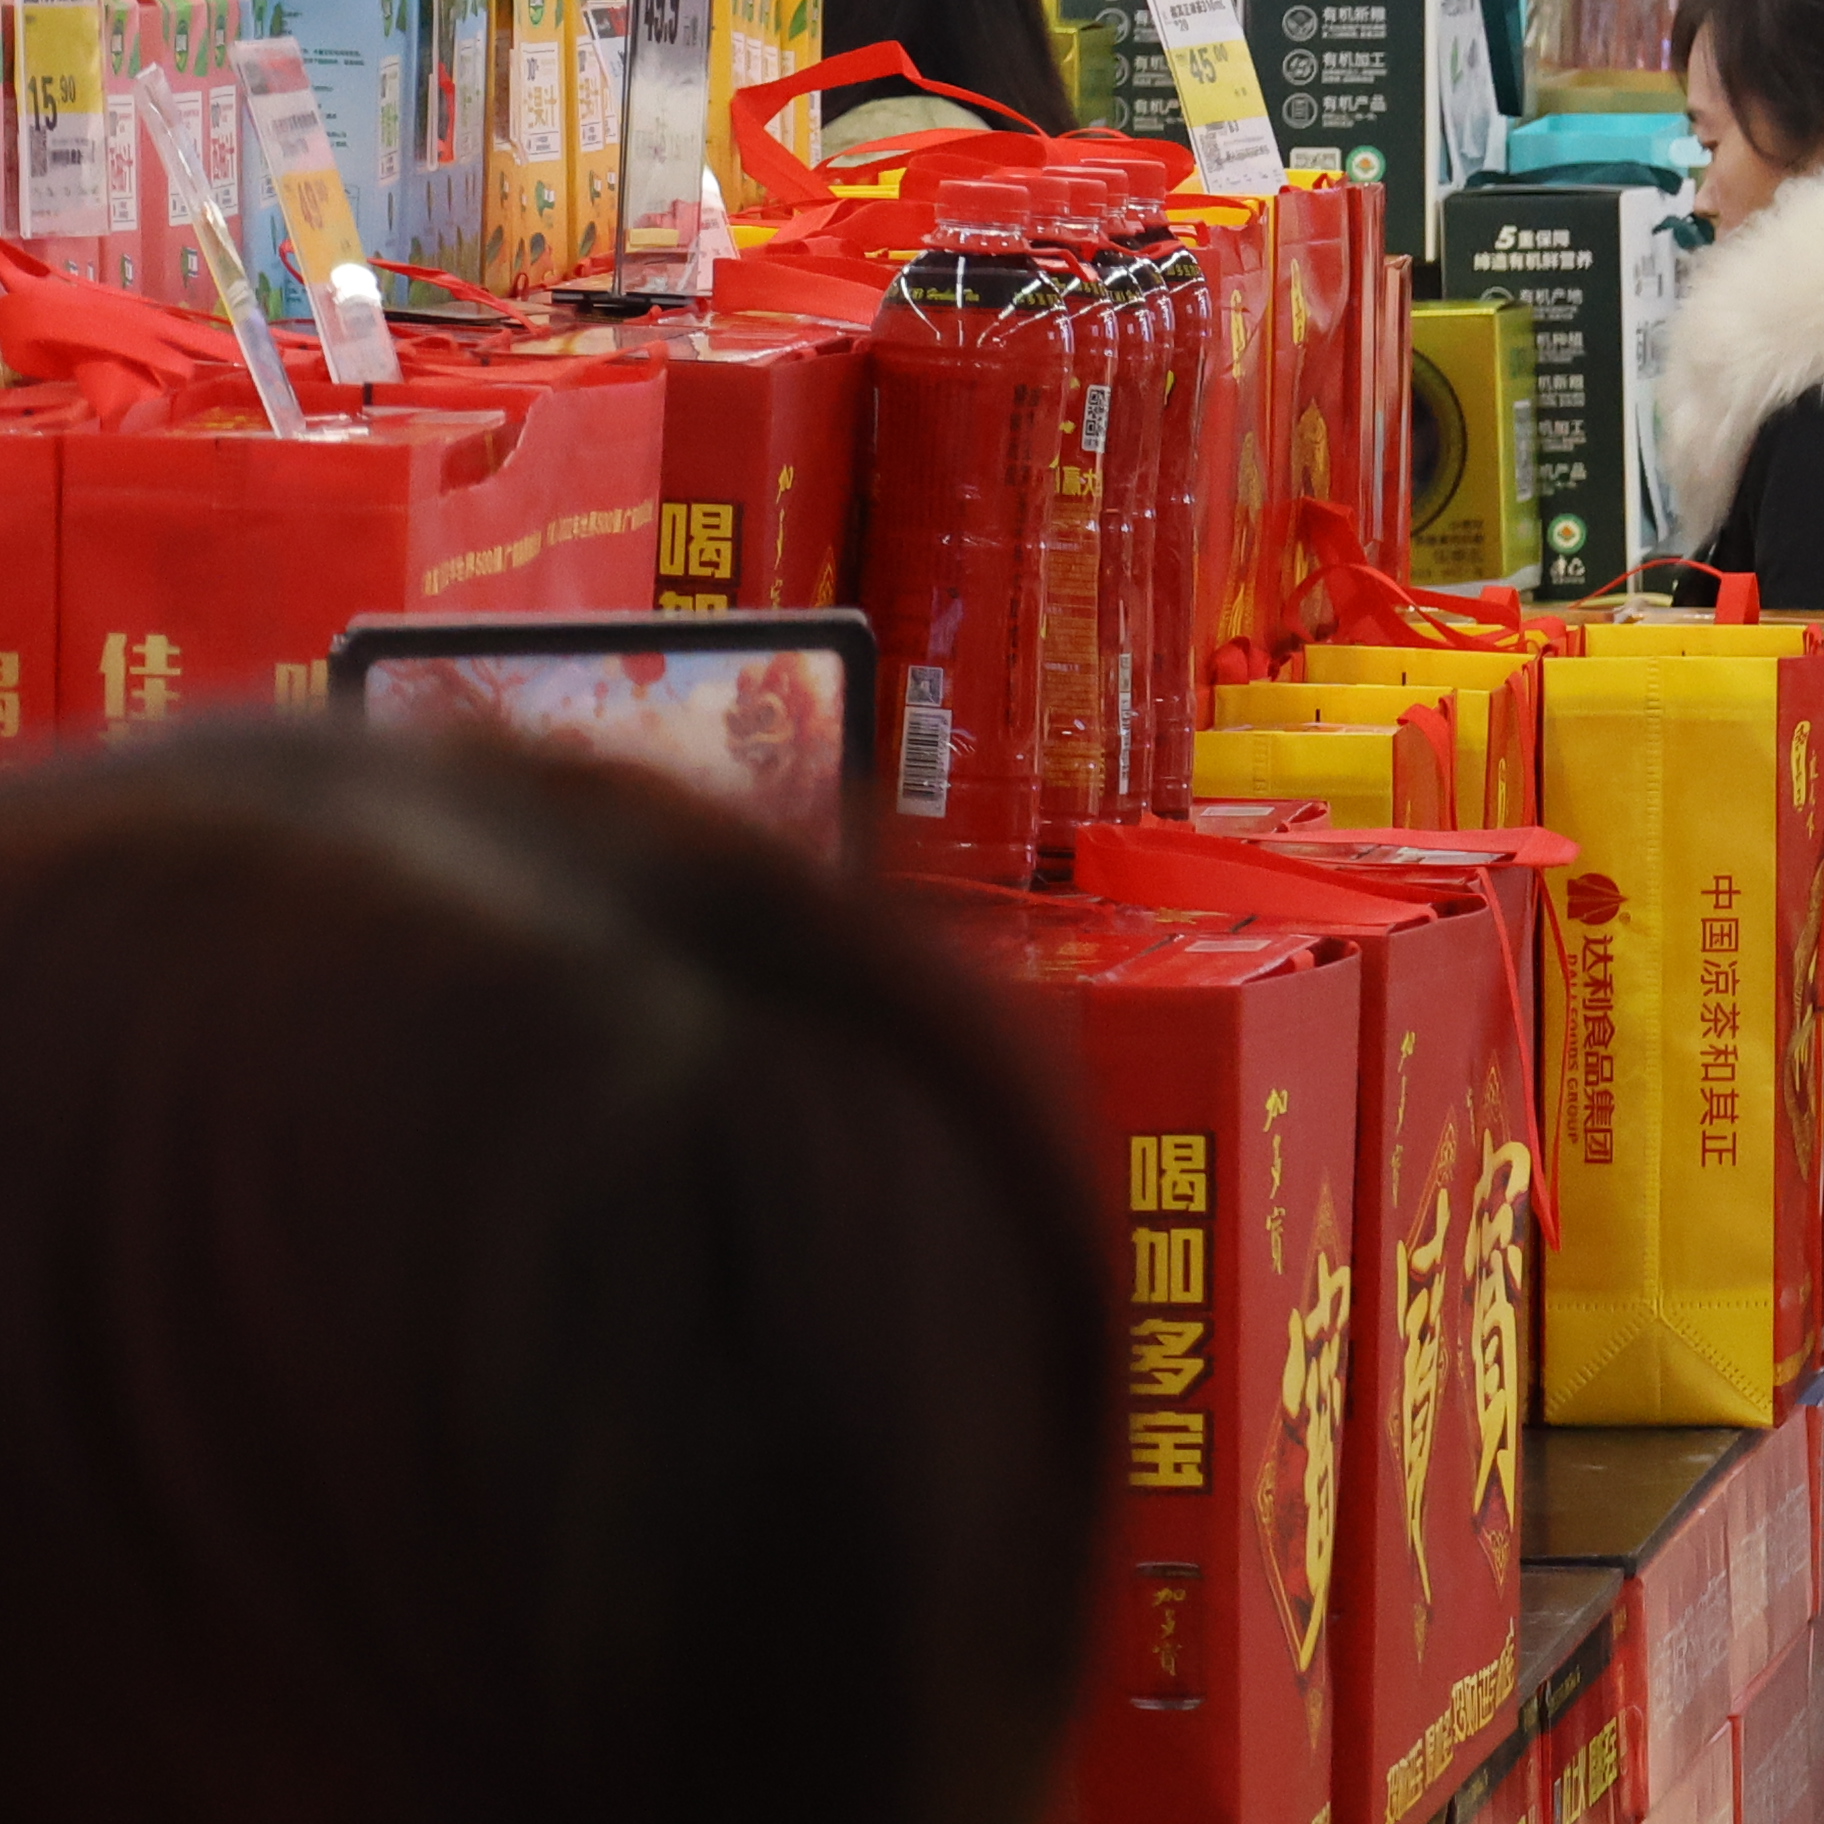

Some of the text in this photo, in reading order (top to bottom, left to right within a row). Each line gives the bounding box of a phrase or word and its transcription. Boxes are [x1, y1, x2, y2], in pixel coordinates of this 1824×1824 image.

[1566, 1077, 1579, 1144] GROUP
[1582, 935, 1615, 1165] 达利食品集团
[1700, 875, 1742, 1168] 中国凉茶和其正
[1129, 1134, 1207, 1486] 喝加多宝
